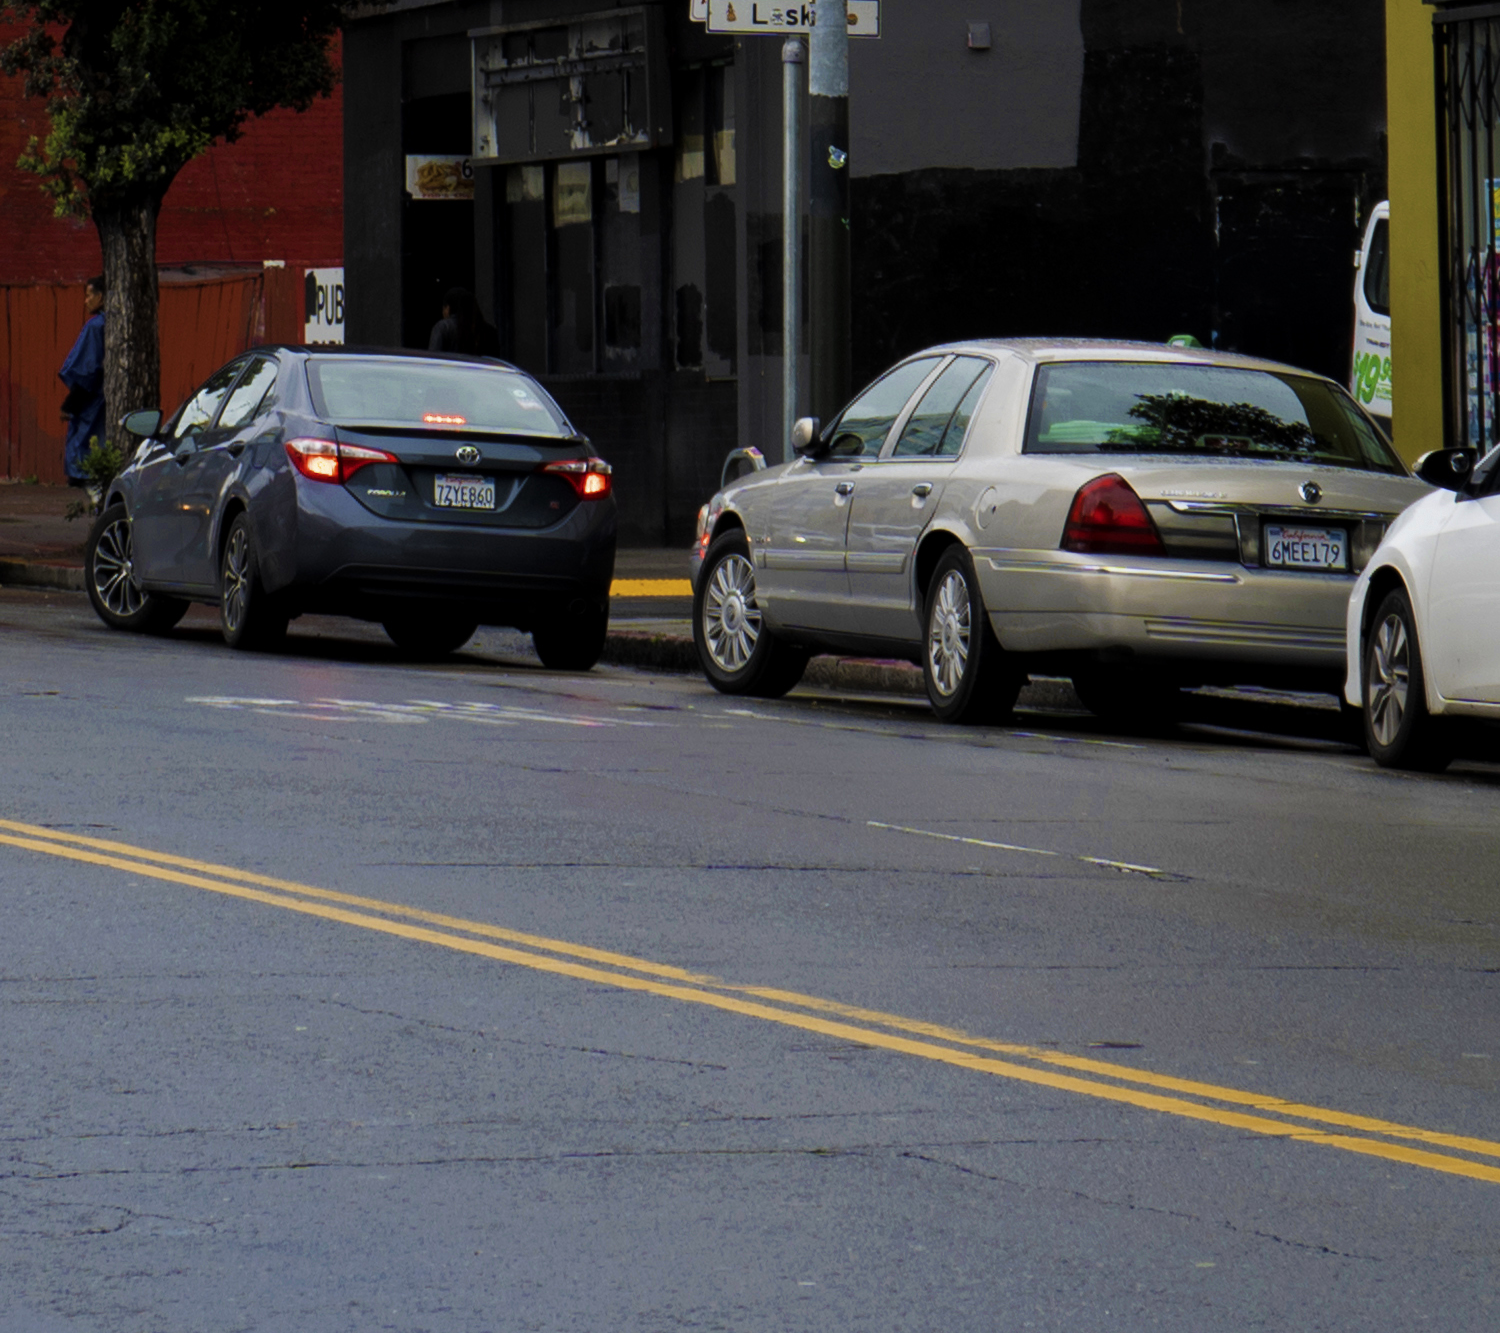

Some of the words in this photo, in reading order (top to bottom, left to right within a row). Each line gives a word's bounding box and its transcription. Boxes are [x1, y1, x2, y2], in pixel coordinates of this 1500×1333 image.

[317, 284, 345, 325] PUB
[436, 484, 494, 504] 7ZYE860
[1272, 540, 1340, 564] 6MEE179
